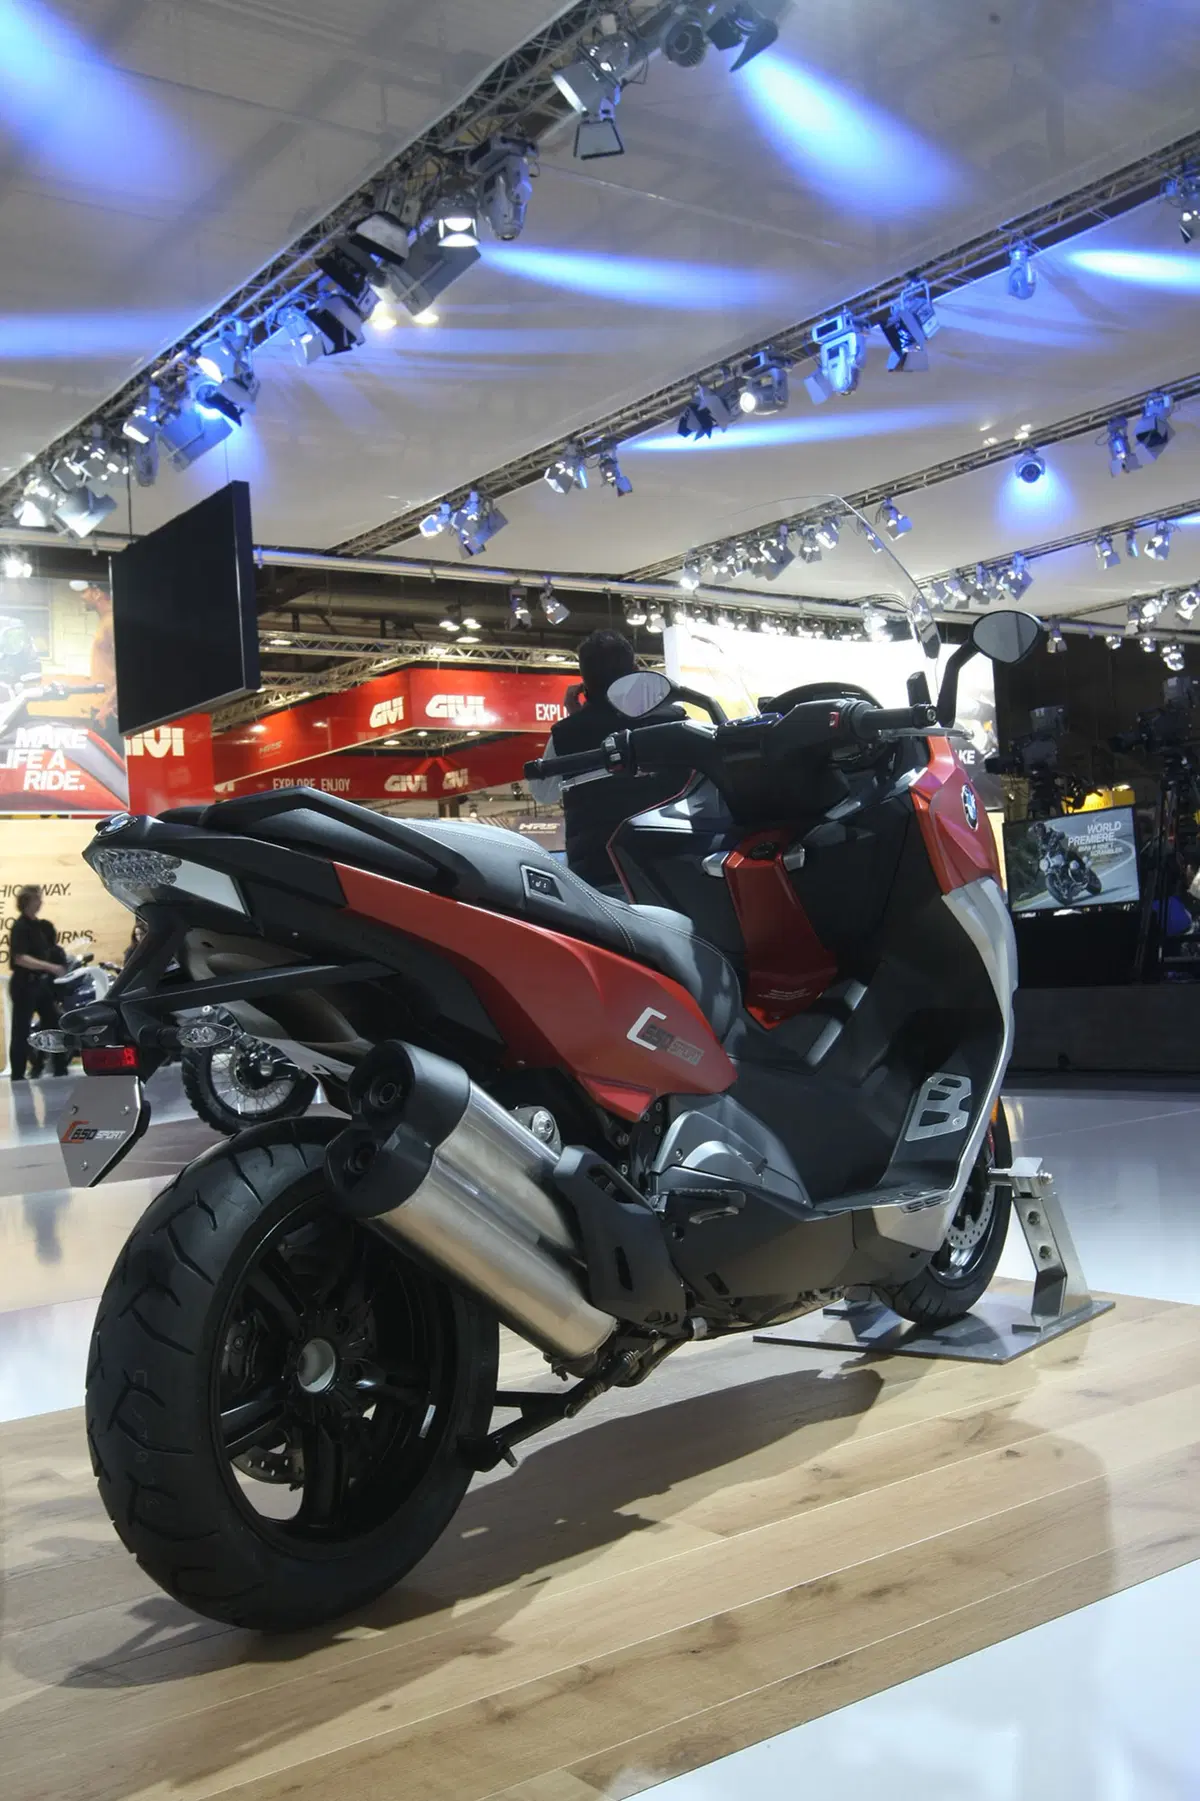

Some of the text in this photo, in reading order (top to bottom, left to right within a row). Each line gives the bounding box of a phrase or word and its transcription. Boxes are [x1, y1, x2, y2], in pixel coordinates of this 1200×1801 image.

[369, 696, 404, 728] GIVI
[15, 726, 88, 749] MAKE
[124, 725, 185, 758] IVI
[47, 749, 66, 769] A
[23, 769, 86, 791] RIDE.
[321, 778, 350, 792] ENJOY
[384, 774, 428, 792] GIVI
[442, 768, 469, 790] GIVI
[1087, 820, 1122, 834] WORLD
